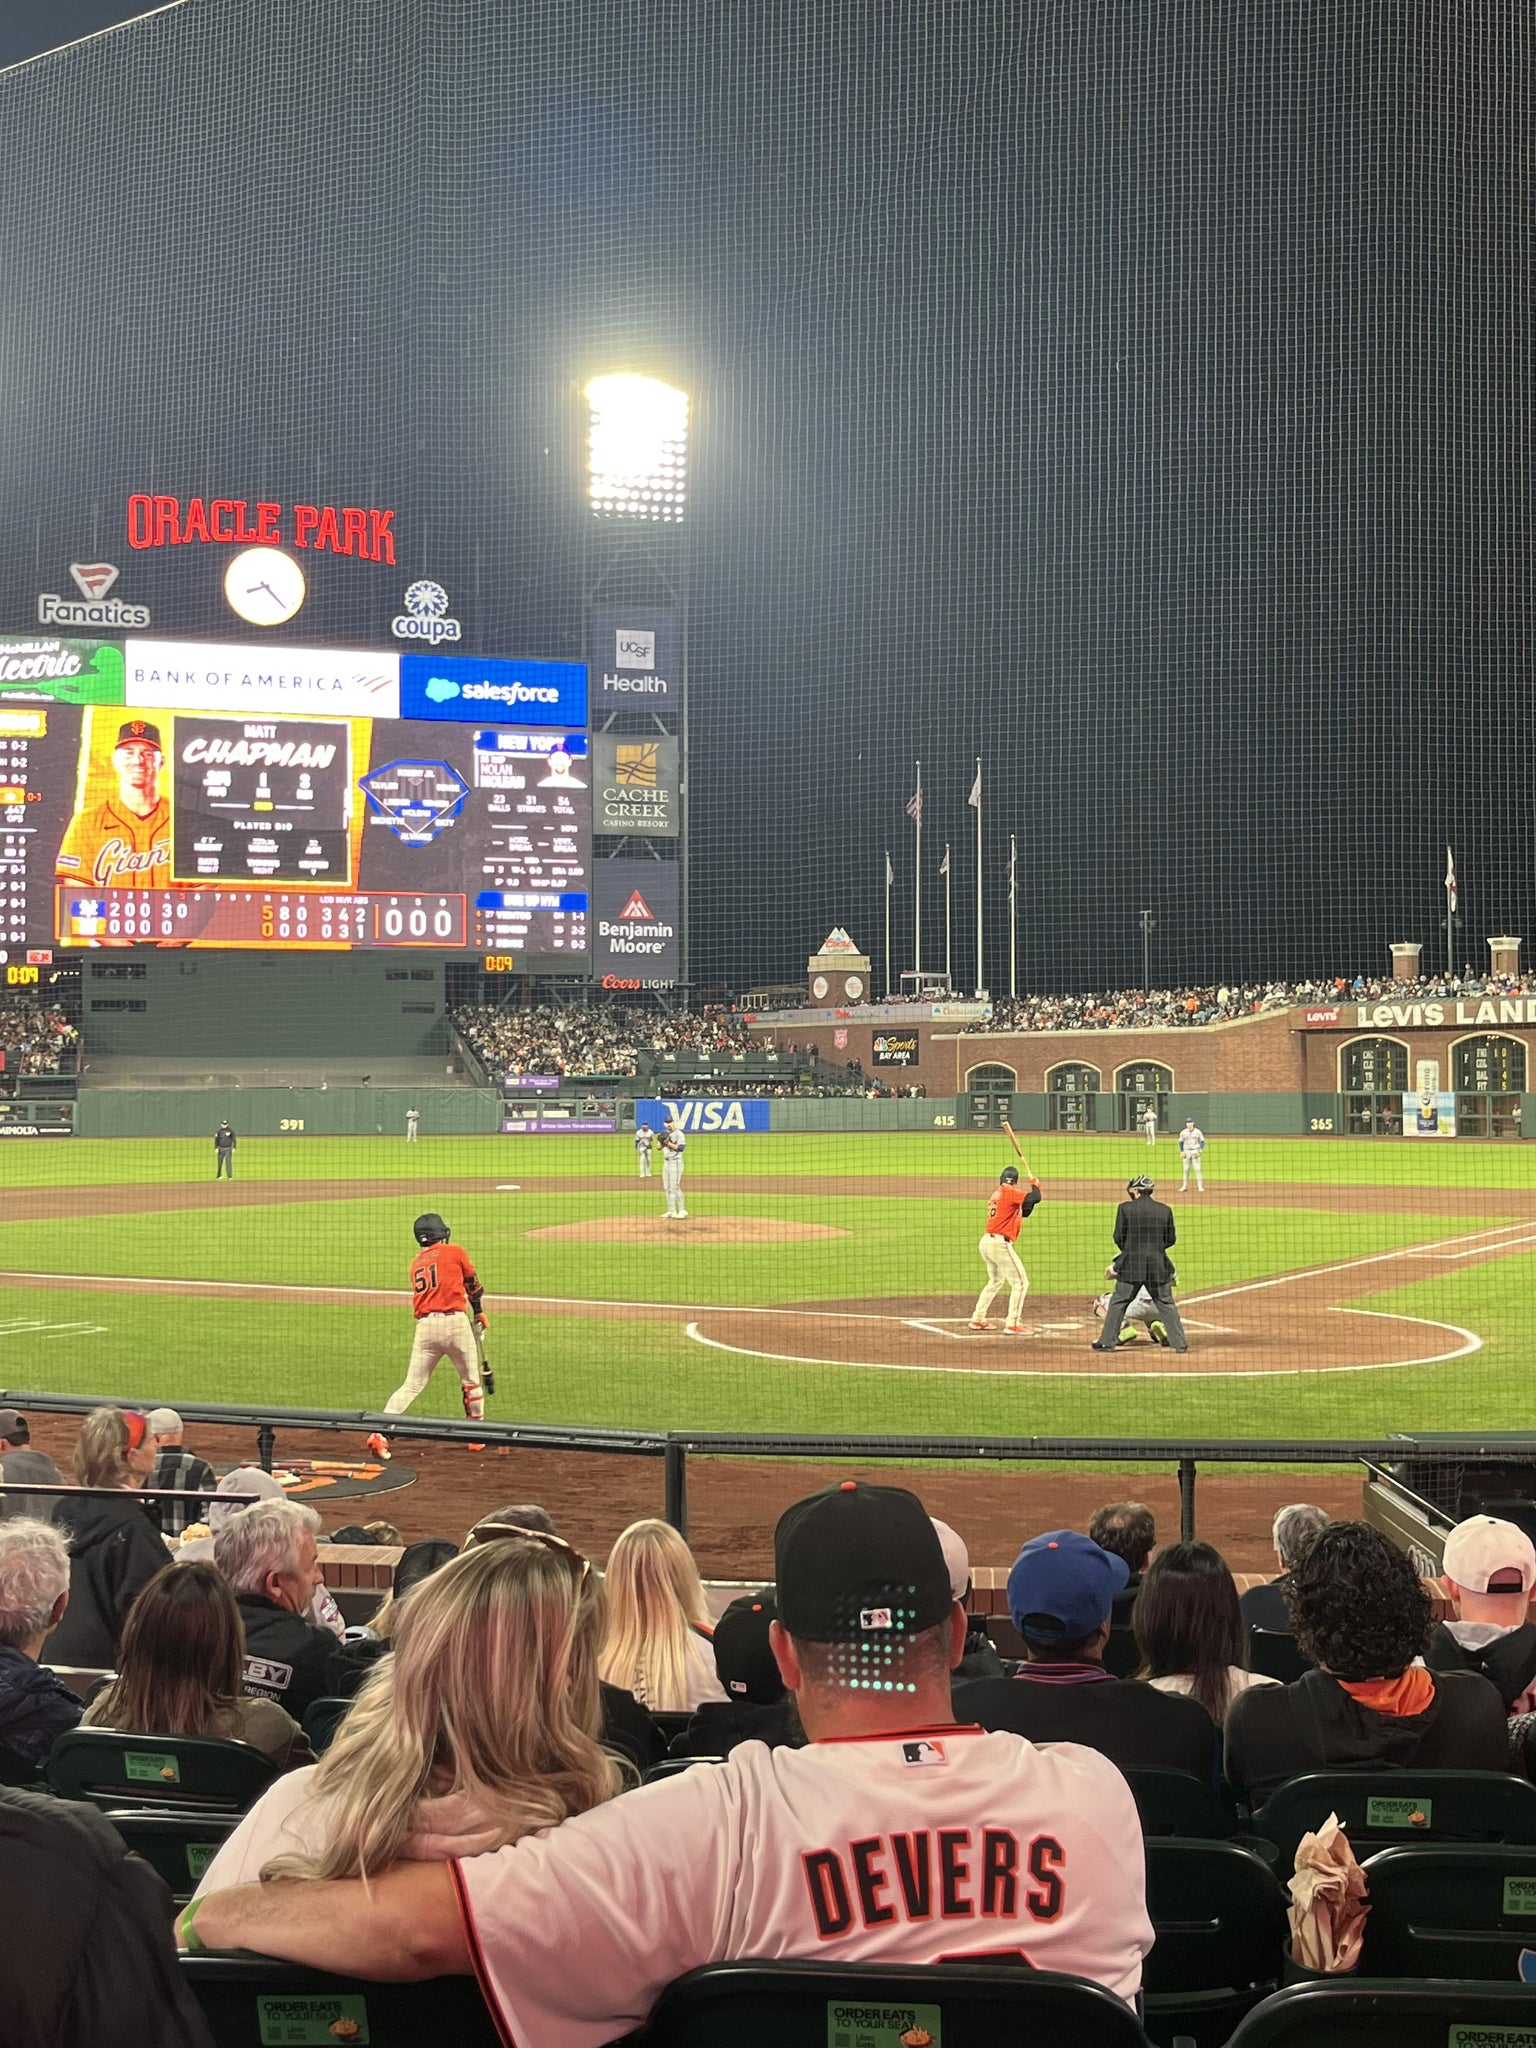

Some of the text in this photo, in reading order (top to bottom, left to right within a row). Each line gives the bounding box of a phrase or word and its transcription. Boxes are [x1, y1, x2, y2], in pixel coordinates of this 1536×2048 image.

[128, 494, 396, 566] ORACLE PARK
[43, 598, 145, 624] Fanatics
[395, 617, 457, 639] coupa
[620, 641, 651, 658] UCSF
[0, 651, 81, 680] lectric
[135, 668, 343, 691] BANK OF AMERICA
[604, 674, 667, 694] Health
[462, 680, 559, 705] salesforce
[244, 724, 277, 739] MATT
[498, 734, 528, 750] NEW
[182, 738, 336, 769] CHAPMAN
[480, 764, 513, 776] NOLAN
[493, 794, 570, 806] 23 31 54
[603, 788, 669, 802] CACHE
[488, 804, 576, 815] BALLS STRIKES TOTAL
[605, 803, 667, 818] CREEK
[233, 821, 293, 831] PLAYER BIO
[603, 819, 669, 828] CASINO RESORT
[109, 903, 366, 922] 2 0 0 3 0 5 8 0 3 4 2
[571, 911, 585, 921] 1-1
[109, 919, 365, 939] 0 0 0 0 0 0 0 0 3 1
[385, 909, 452, 937] 0 0 0
[571, 925, 586, 936] 2-2
[599, 921, 673, 940] Benjamin
[610, 938, 662, 954] Moore
[485, 956, 513, 972] 0:09
[7, 966, 39, 985] 0:09
[601, 973, 676, 990] Coors LIGHT
[887, 1036, 917, 1052] Sports
[879, 1051, 911, 1060] BAY AREA
[1386, 1060, 1391, 1070] 4
[1502, 1071, 1507, 1080] 4
[661, 1101, 746, 1131] VISA
[934, 1114, 955, 1127] 415
[279, 1118, 305, 1131] 391
[1310, 1118, 1333, 1131] 365
[414, 1263, 437, 1294] 51
[244, 1661, 285, 1682] BY
[244, 1684, 281, 1701] REGION
[802, 1827, 1066, 1941] DEVERS
[264, 2001, 342, 2012] ORDER EATS
[834, 2007, 916, 2021] ORDER EATS
[266, 2012, 281, 2020] TO
[285, 2012, 312, 2020] YOUR
[835, 2019, 851, 2028] TO
[853, 2020, 885, 2029] YOUR
[1456, 2031, 1505, 2043] ORDER
